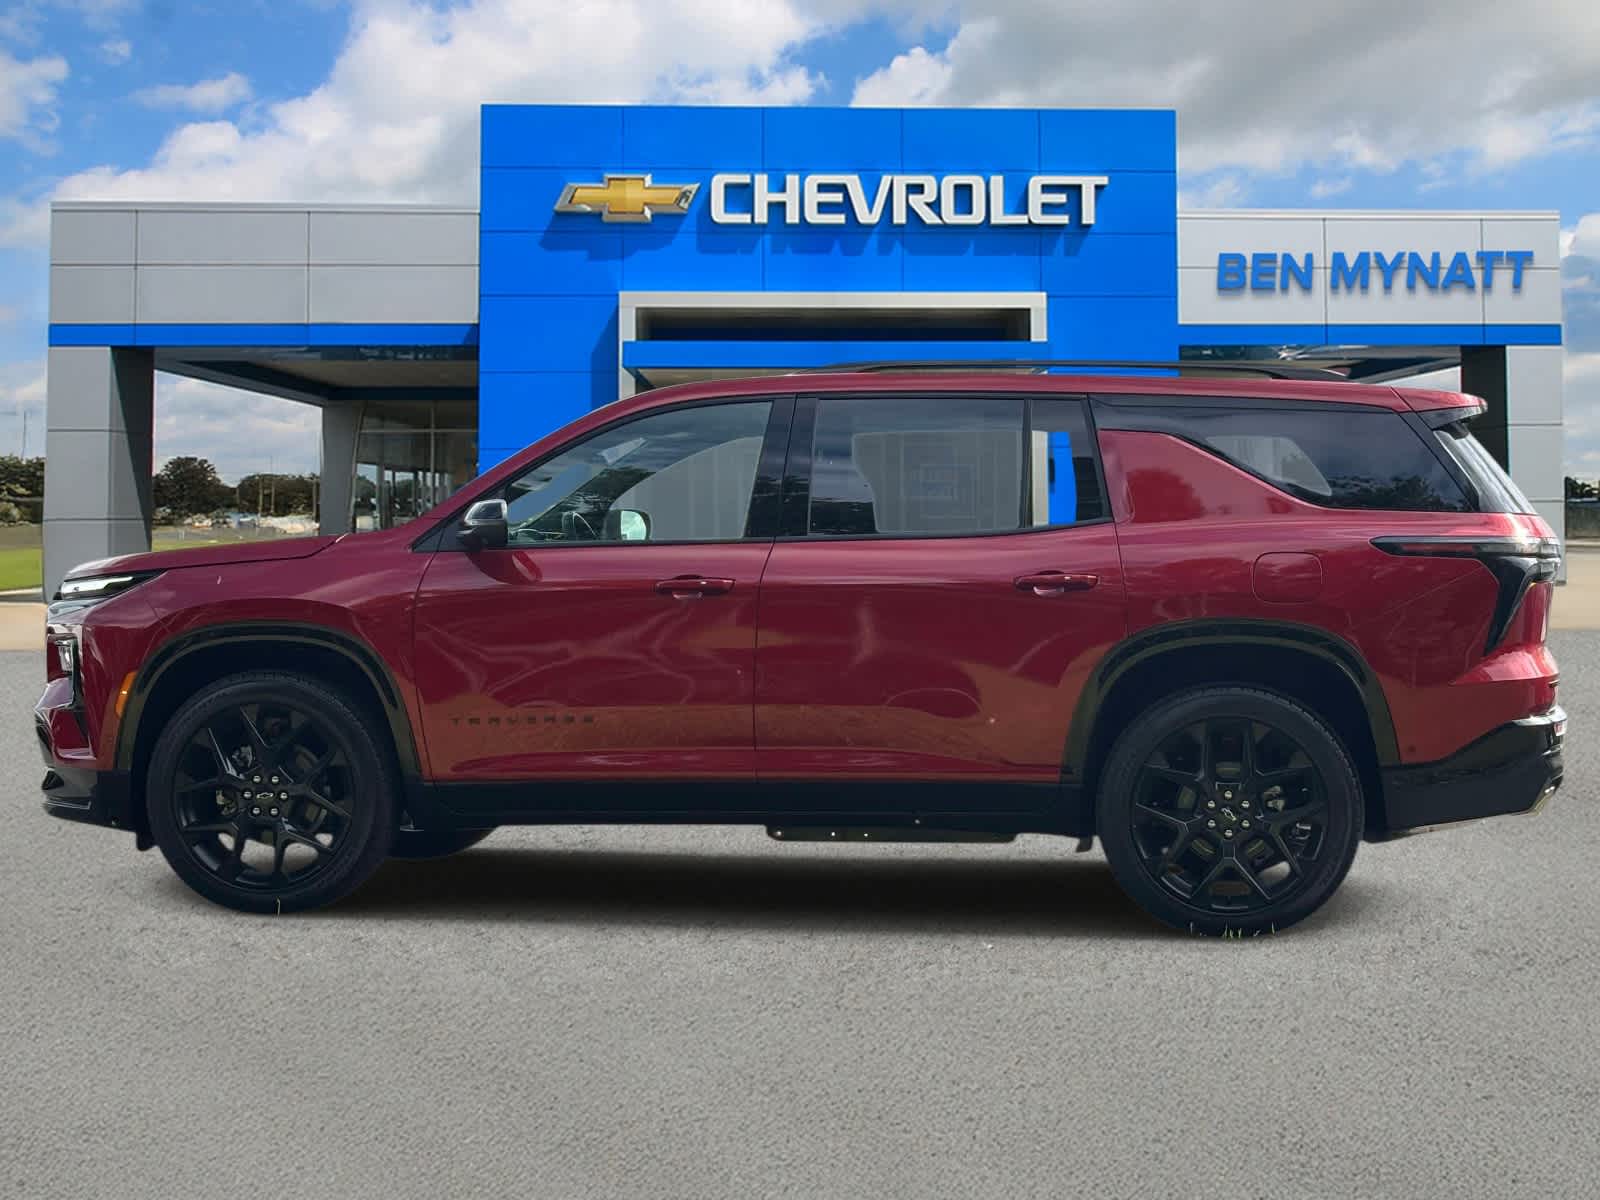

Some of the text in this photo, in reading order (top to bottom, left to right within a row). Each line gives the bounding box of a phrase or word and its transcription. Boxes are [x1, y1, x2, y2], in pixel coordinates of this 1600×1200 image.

[710, 174, 1109, 225] CHEVROLET
[1217, 250, 1534, 291] BEN MYNATT
